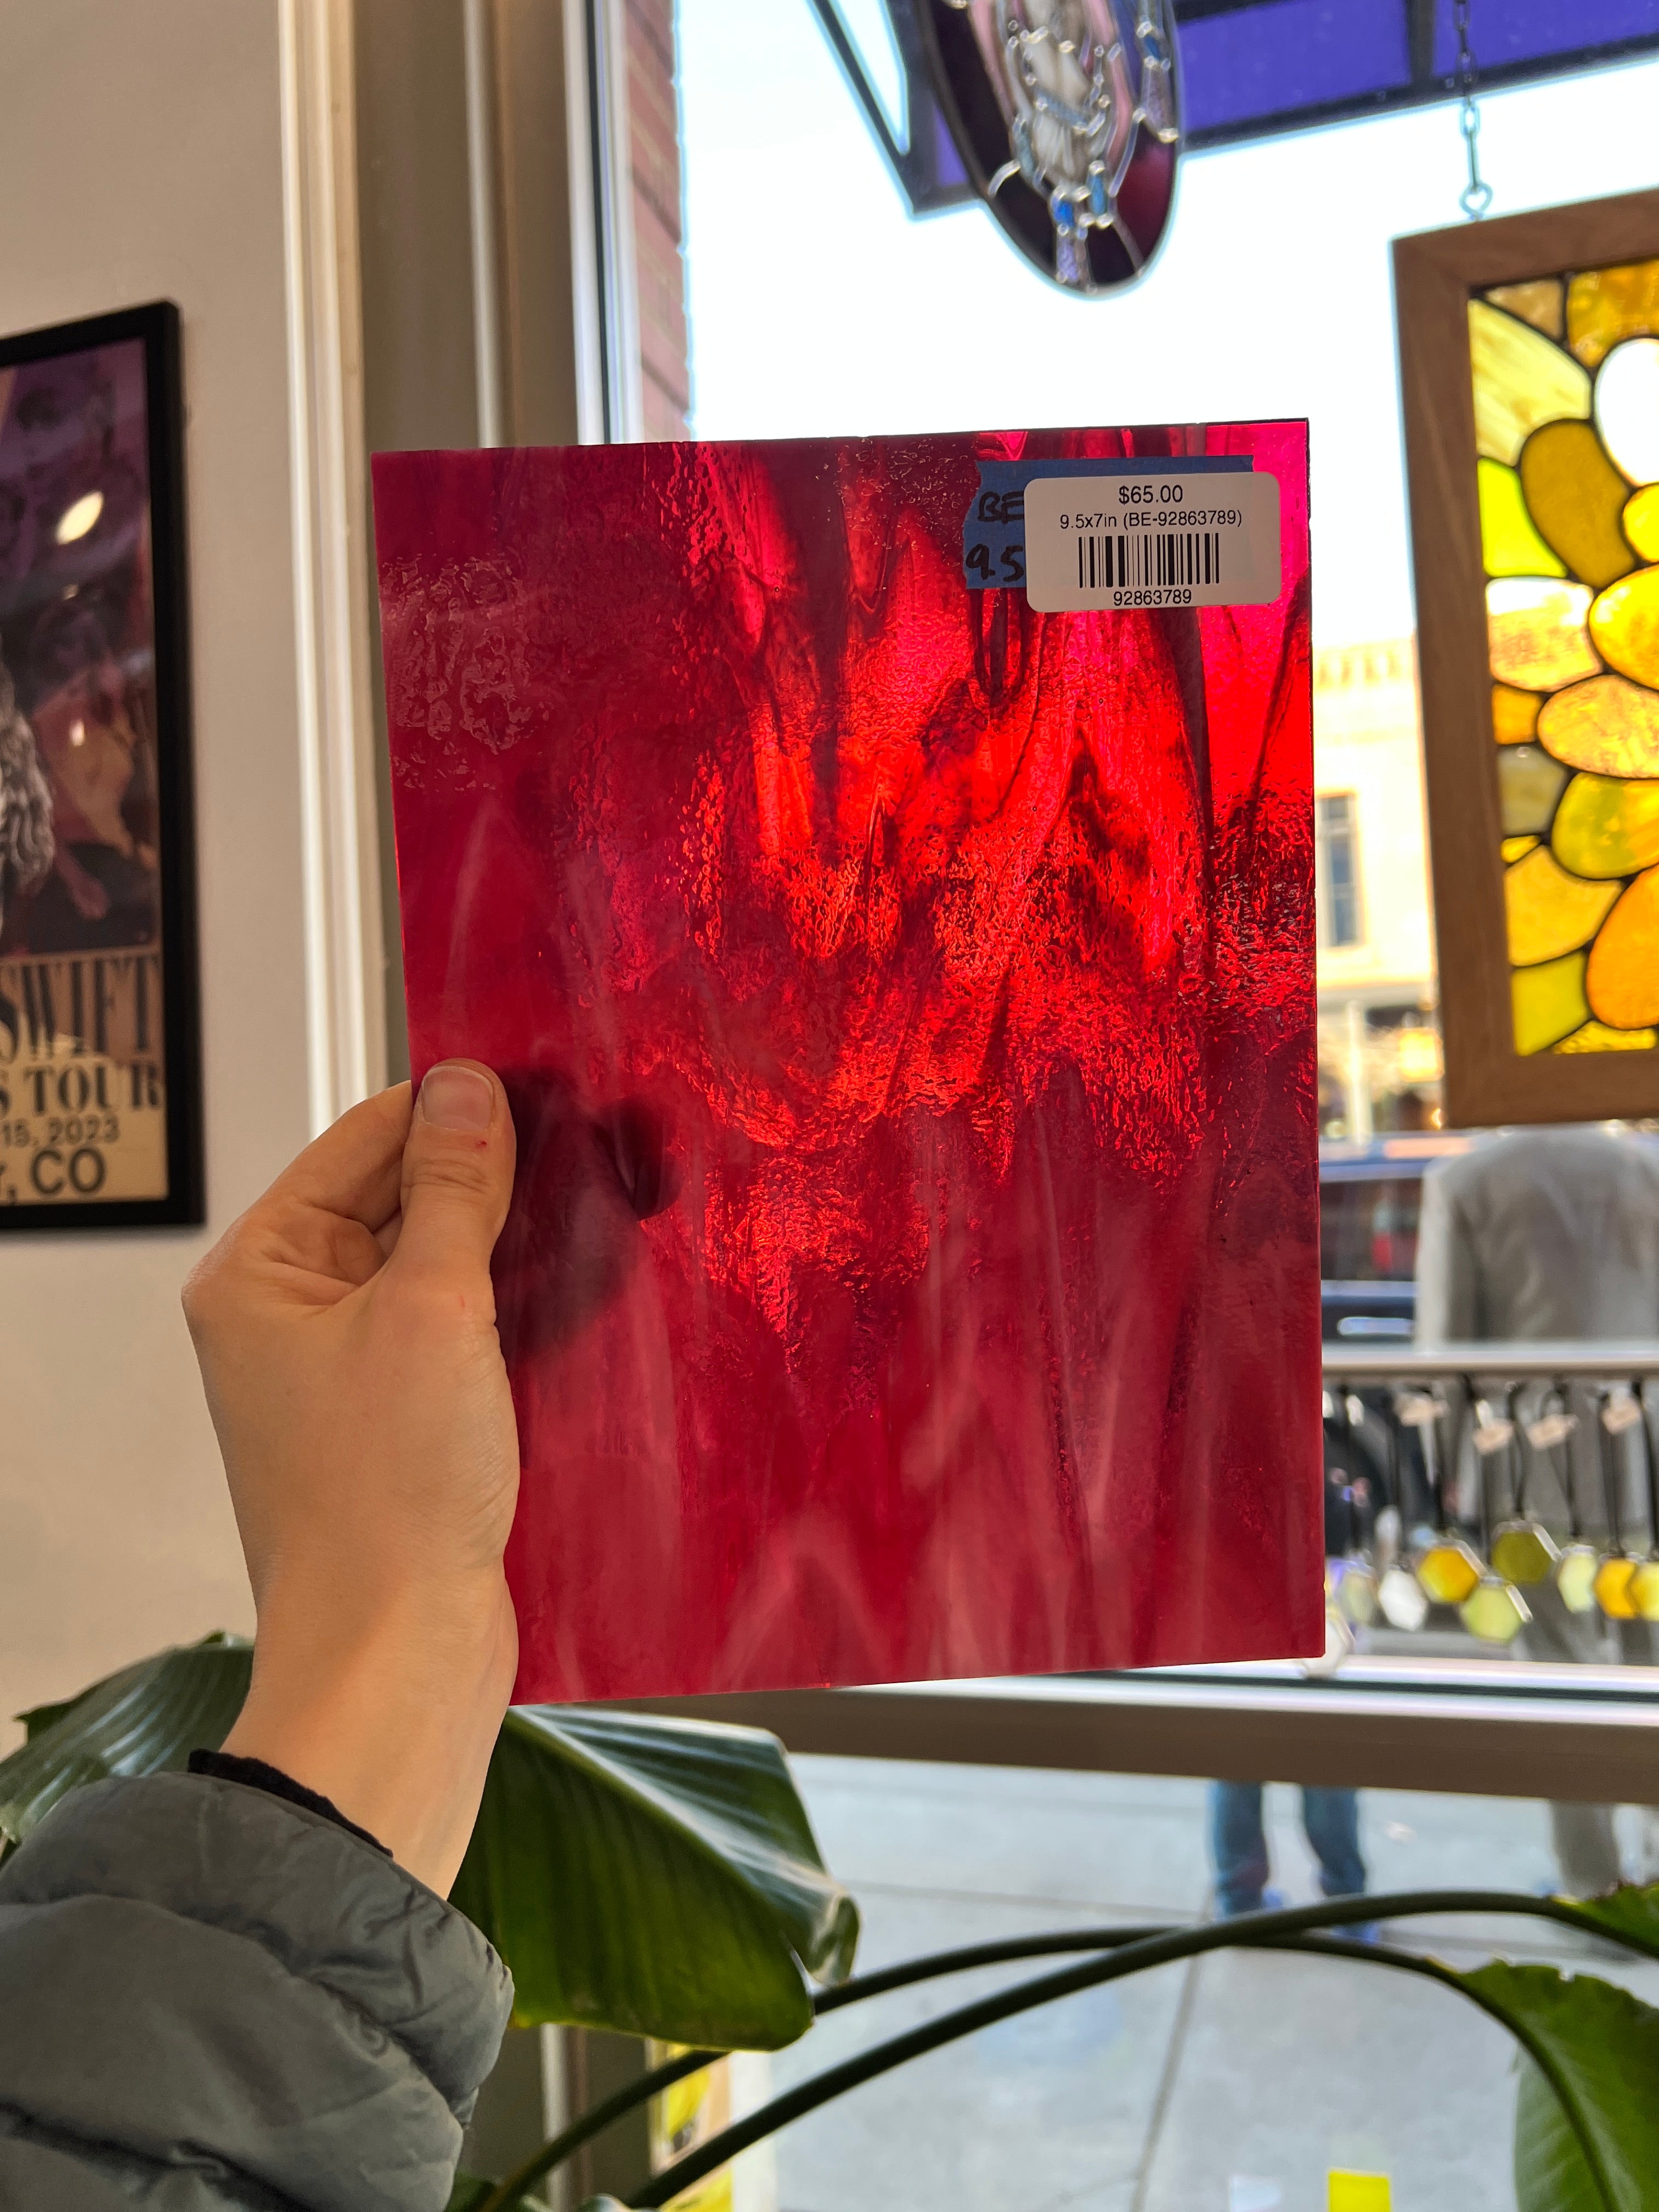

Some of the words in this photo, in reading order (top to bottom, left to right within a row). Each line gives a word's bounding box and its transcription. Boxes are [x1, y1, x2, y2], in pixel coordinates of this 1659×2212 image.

[978, 490, 1024, 524] BE
[1119, 485, 1183, 505] $65.00
[1060, 513, 1117, 529] 9.5x7in
[1123, 510, 1242, 530] (BE-92863789)
[966, 544, 1024, 583] 9.5
[1114, 589, 1192, 606] 92863789
[23, 1062, 163, 1115] TOUR
[49, 1114, 120, 1146] 2023
[31, 1147, 106, 1194] CO
